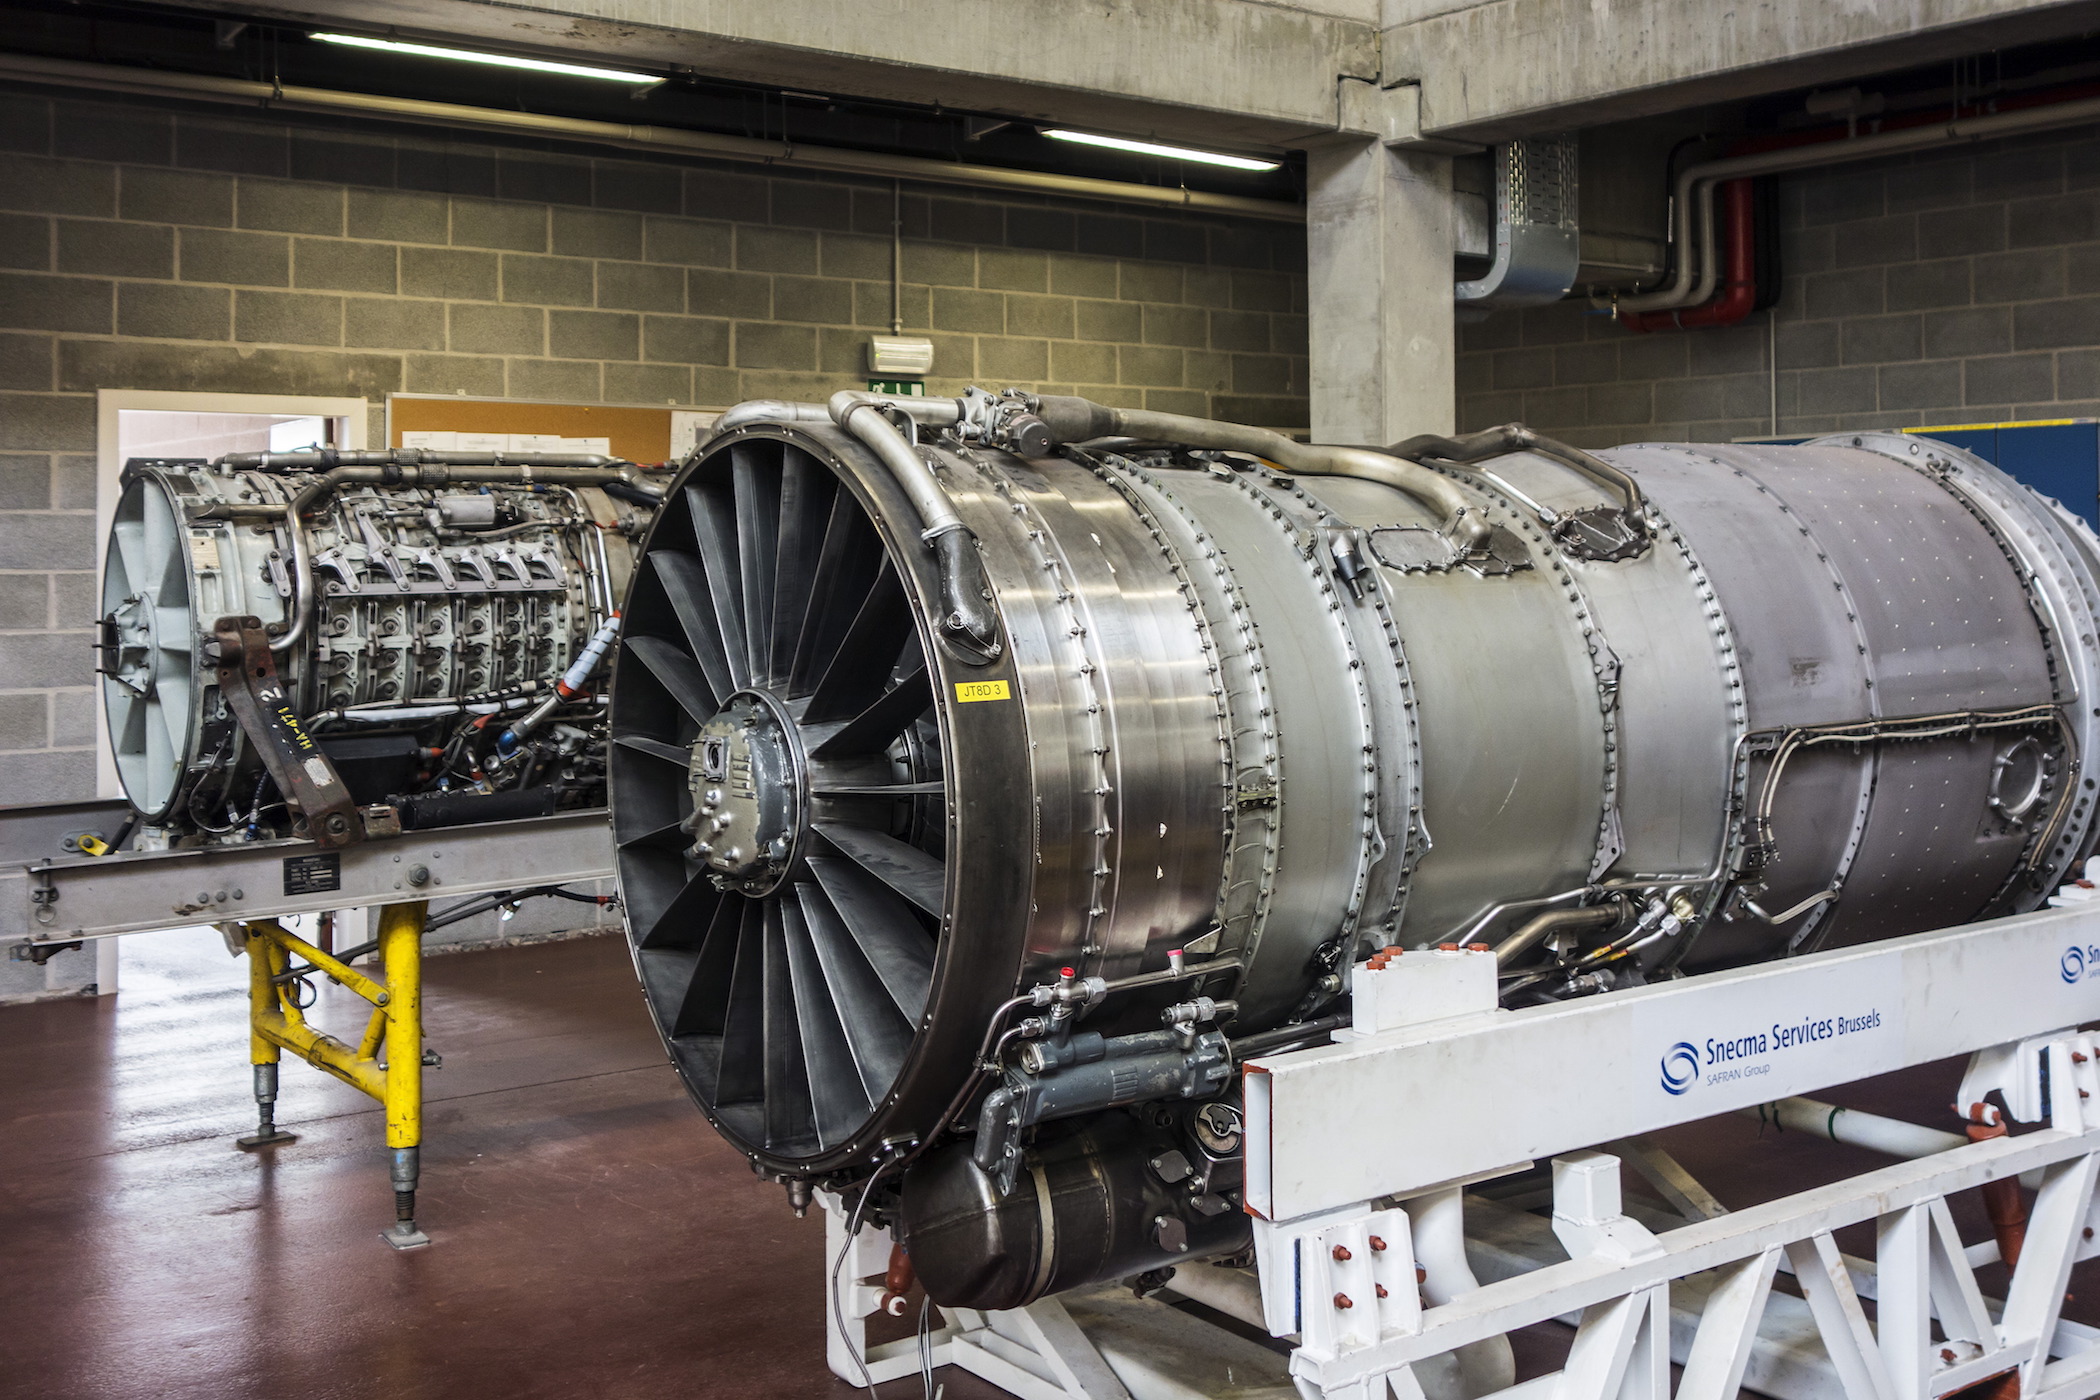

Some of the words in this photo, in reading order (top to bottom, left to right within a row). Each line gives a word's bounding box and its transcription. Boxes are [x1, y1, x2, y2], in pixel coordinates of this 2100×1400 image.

[964, 684, 991, 697] JT8D
[994, 684, 1001, 695] 3
[1706, 1033, 1767, 1065] Snecma
[1772, 1016, 1833, 1050] Services
[1838, 1008, 1881, 1035] Brussels
[1706, 1069, 1741, 1086] SAFRAN
[1744, 1064, 1770, 1077] Group
